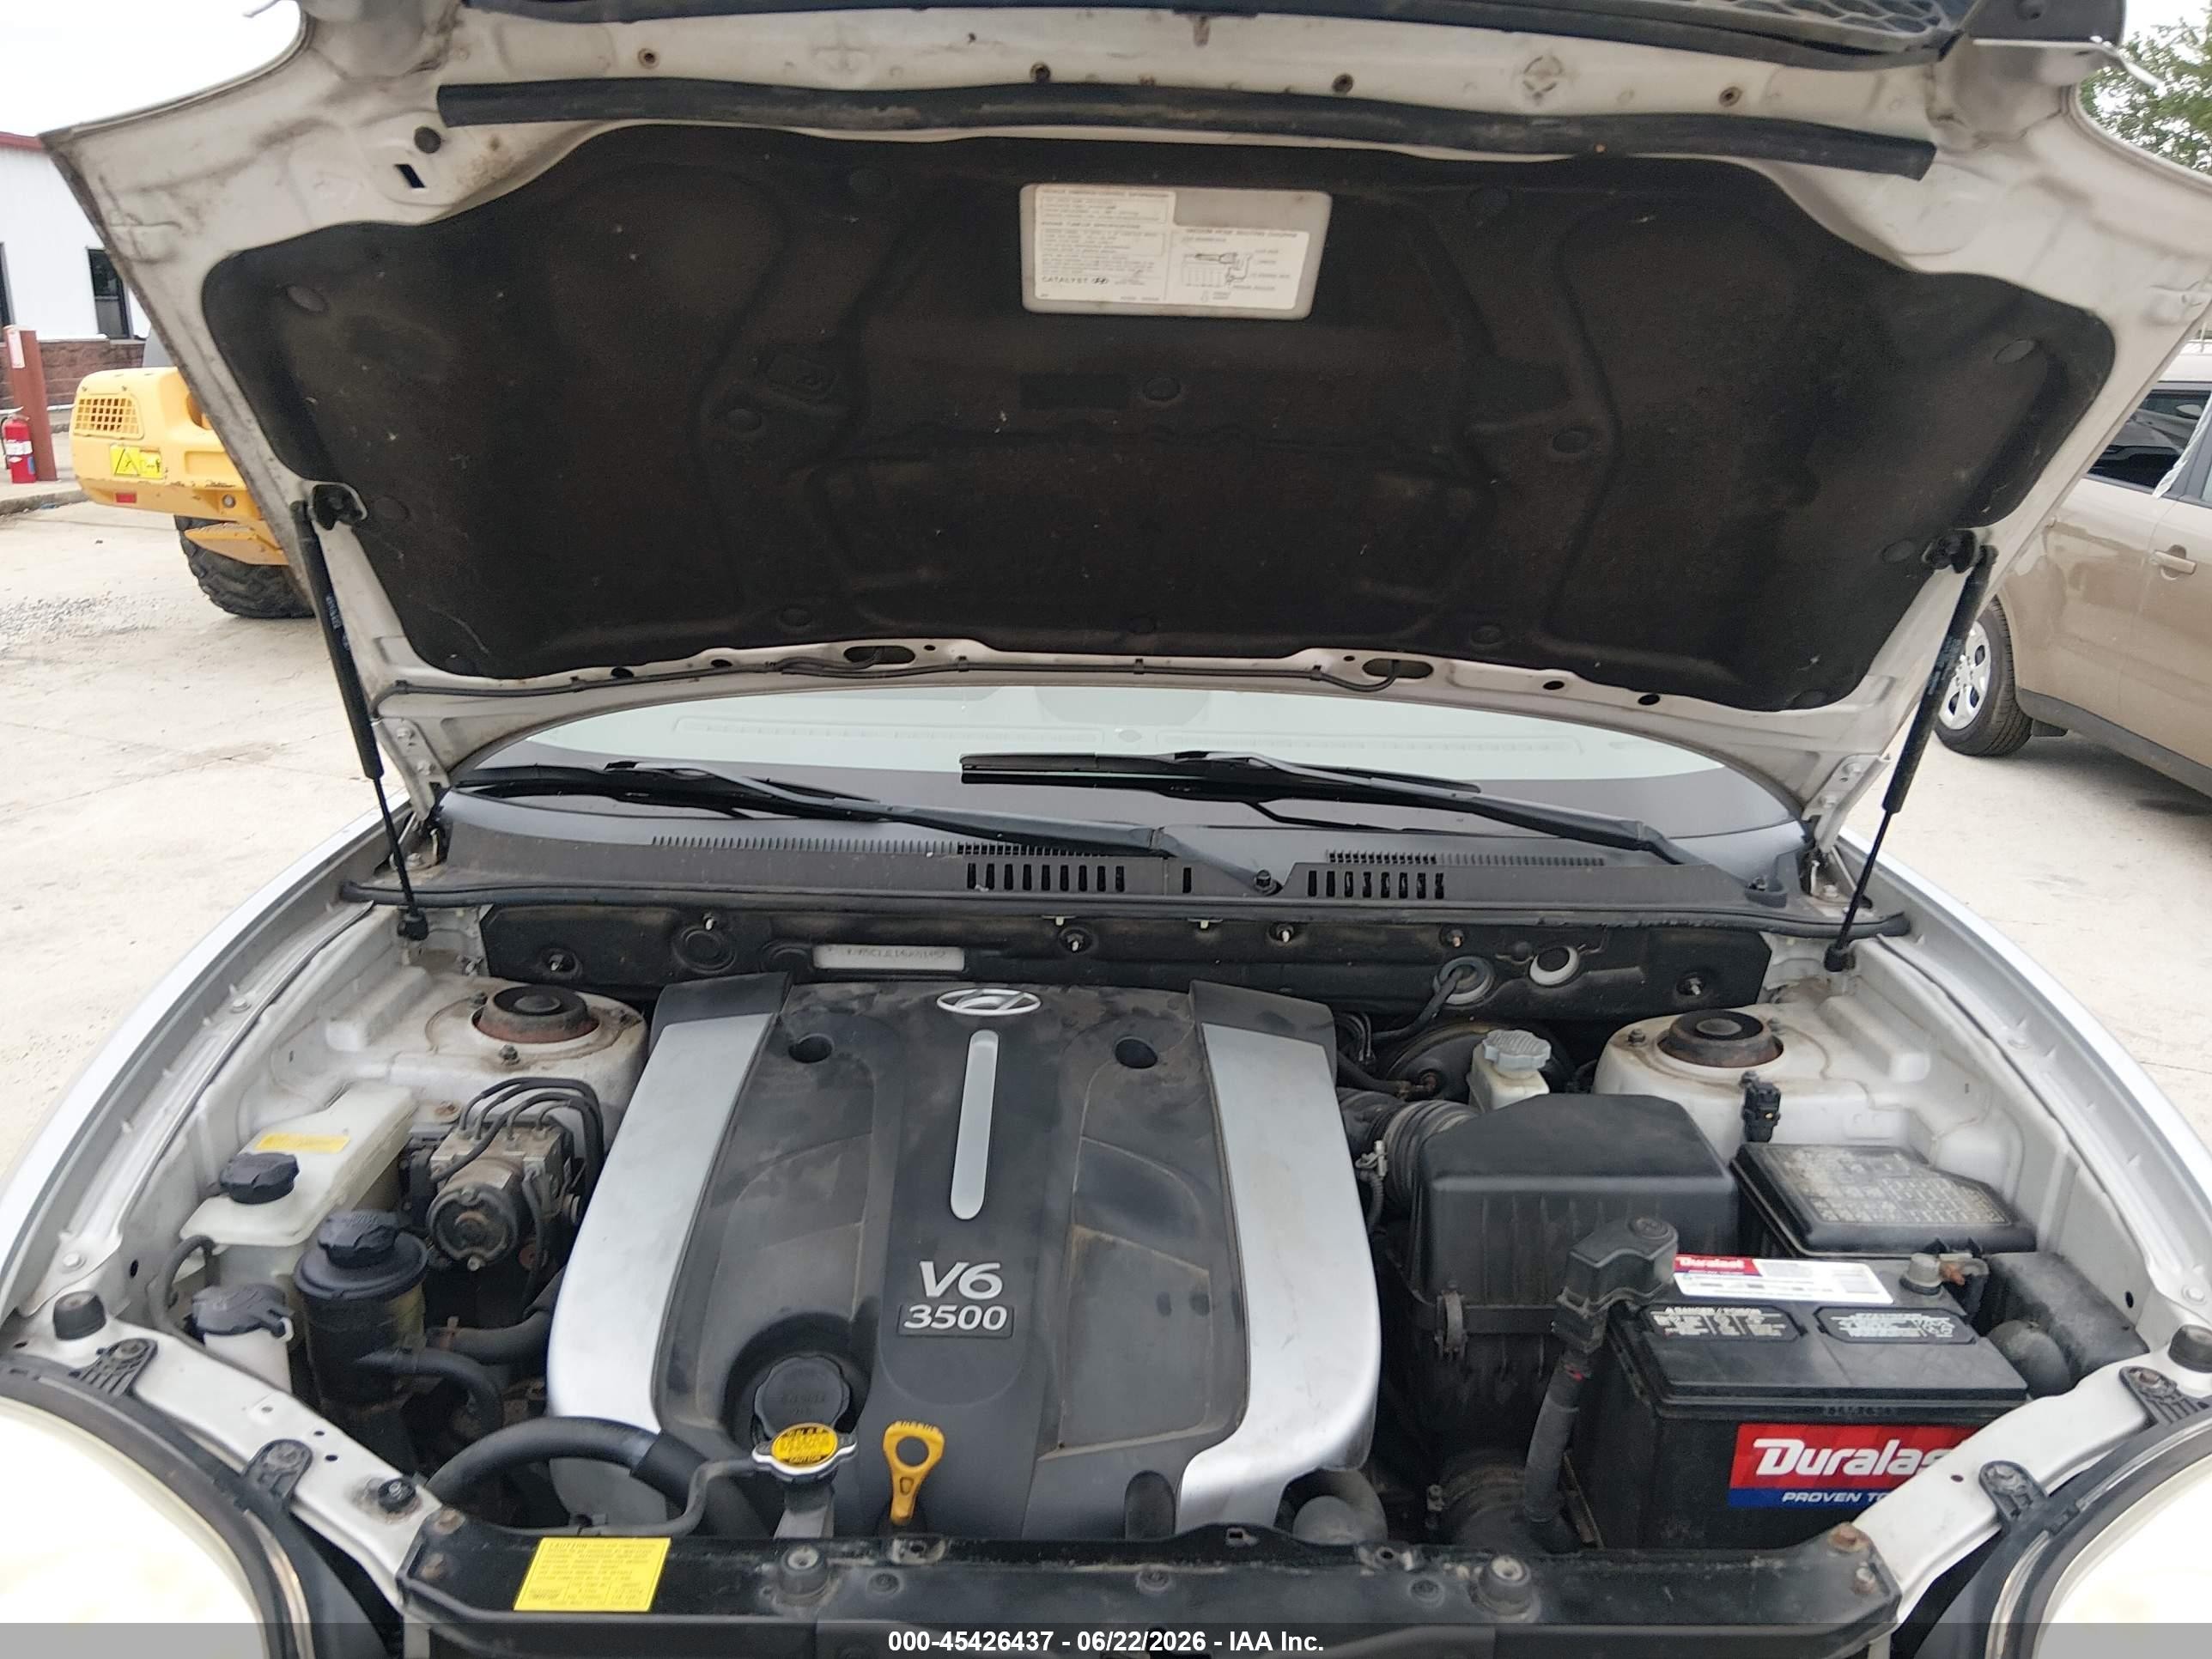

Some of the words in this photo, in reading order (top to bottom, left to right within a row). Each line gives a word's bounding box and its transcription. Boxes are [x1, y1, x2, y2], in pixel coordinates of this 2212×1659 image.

[920, 1261, 1003, 1300] V6
[903, 1304, 1007, 1330] 3500
[1782, 1492, 1862, 1503] PROVEN
